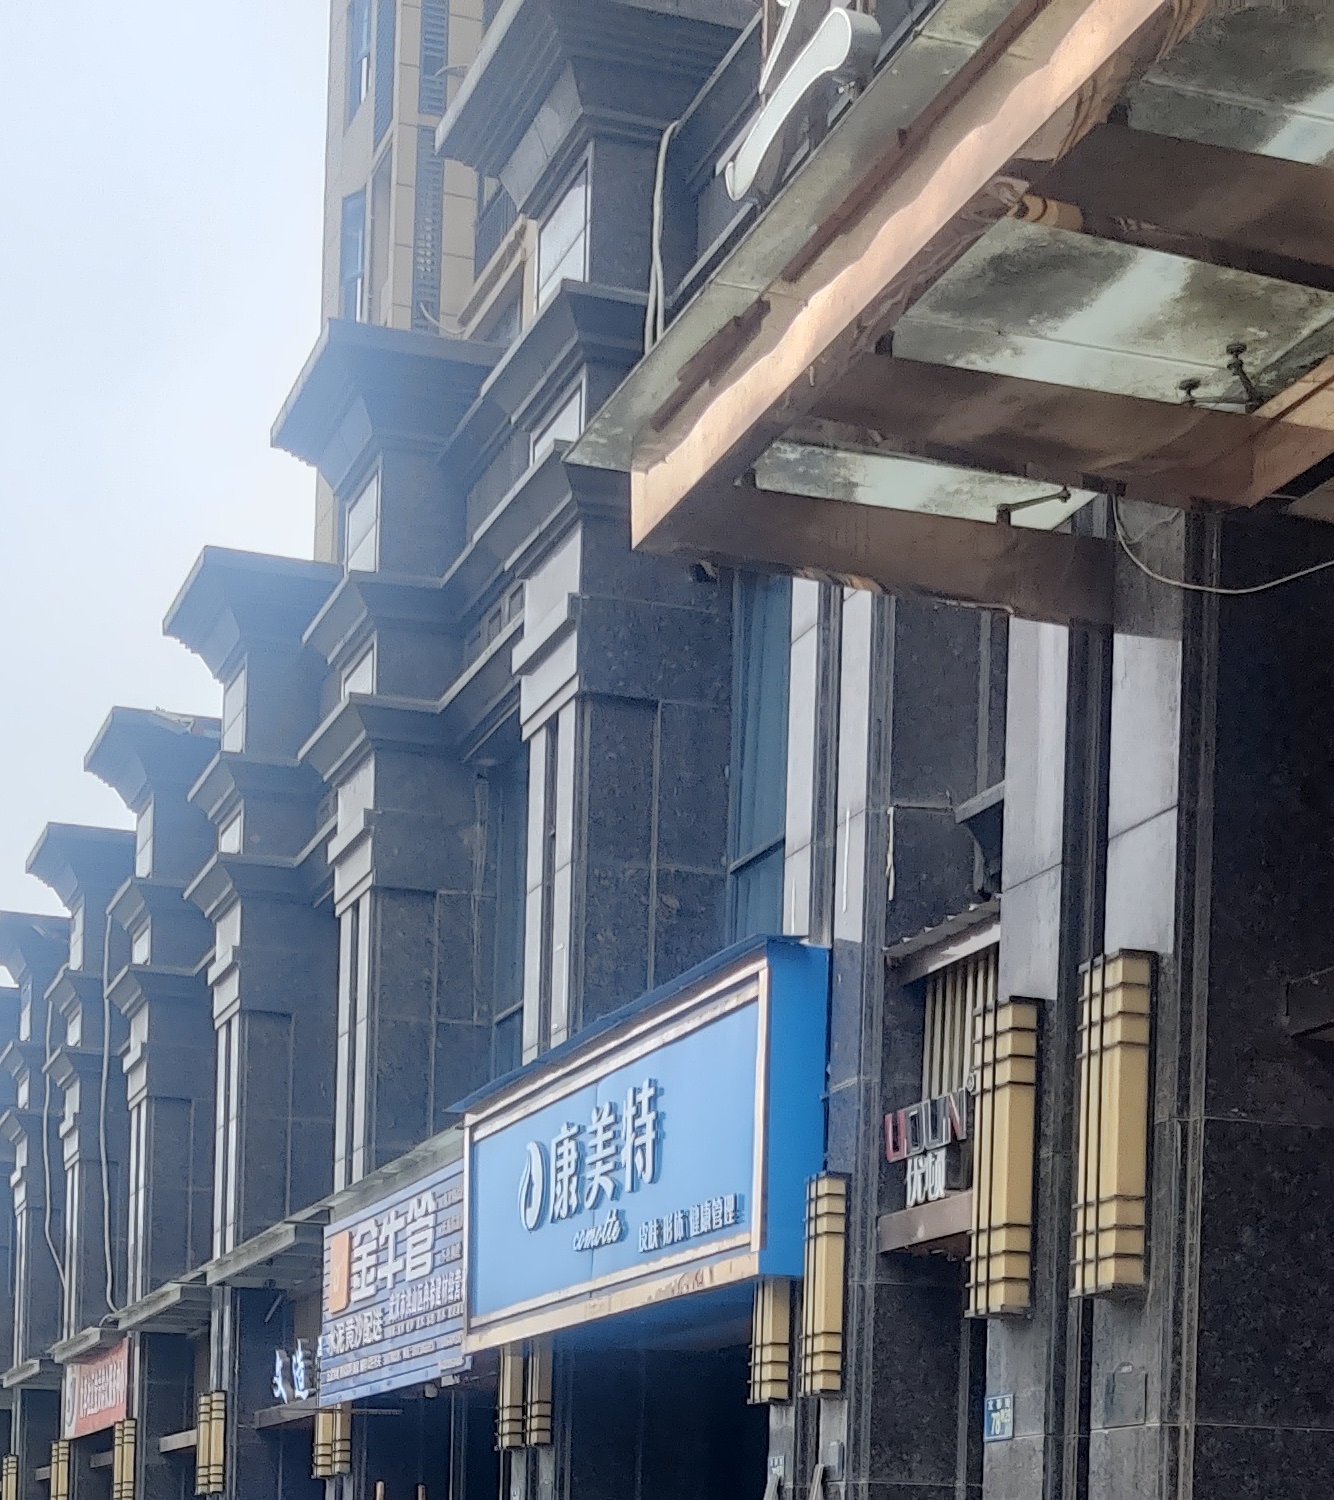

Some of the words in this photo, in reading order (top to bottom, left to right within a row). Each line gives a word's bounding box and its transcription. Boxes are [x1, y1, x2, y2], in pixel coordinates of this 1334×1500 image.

[550, 1077, 657, 1223] 康美特
[907, 1148, 946, 1207] 优顿
[352, 1191, 437, 1303] 金牛管
